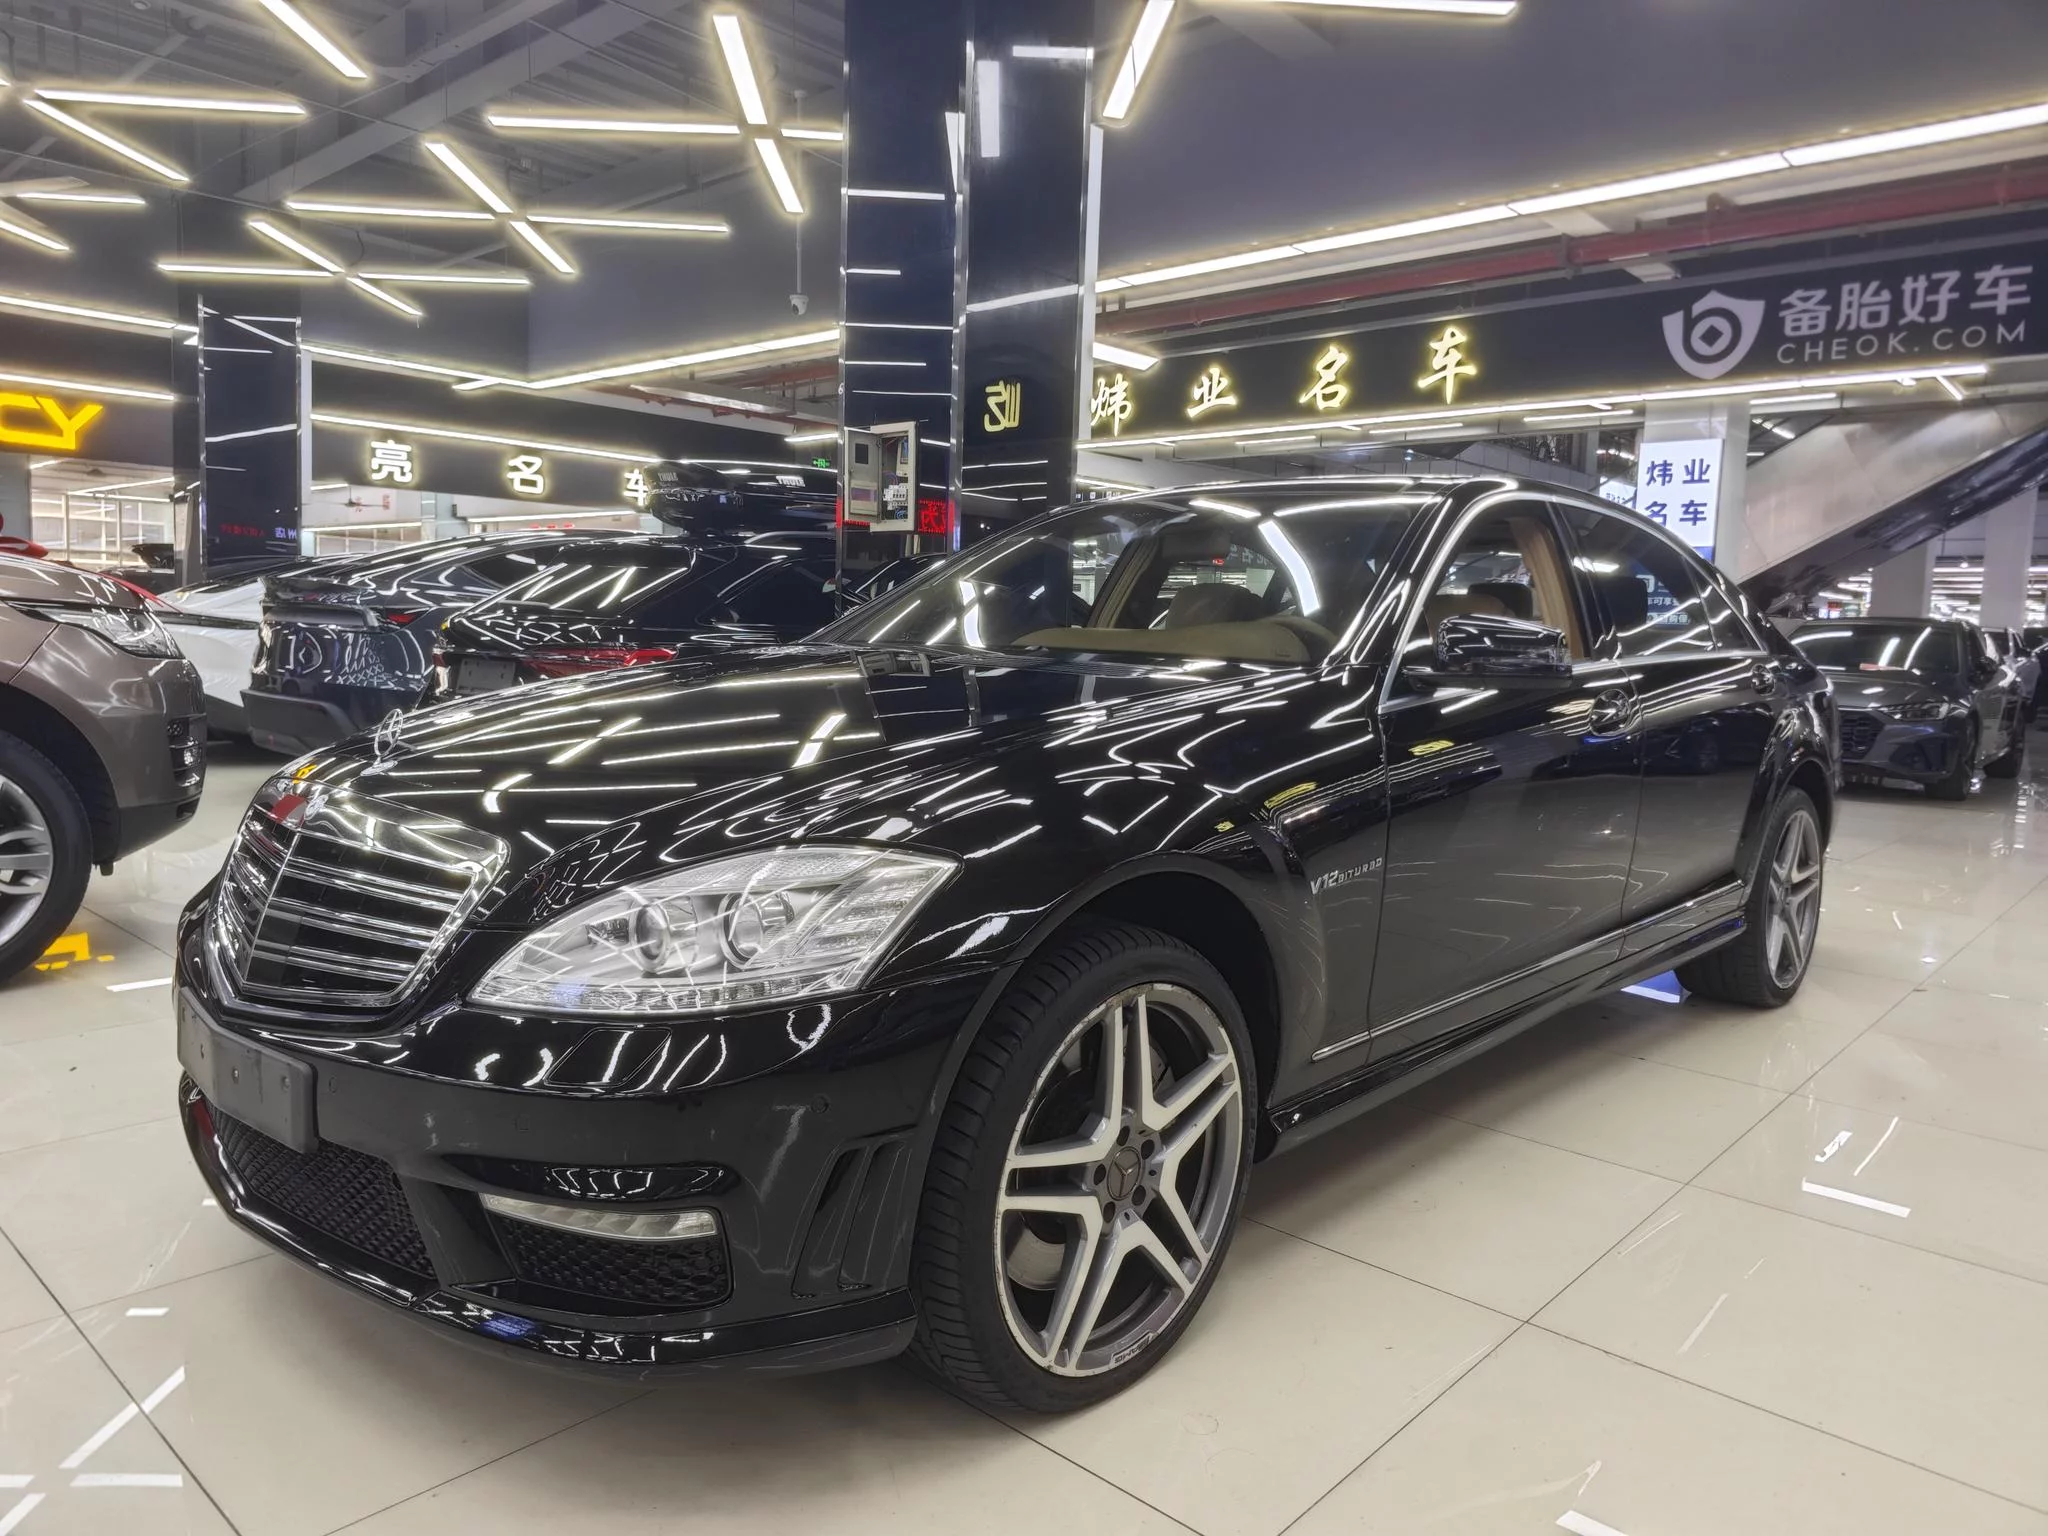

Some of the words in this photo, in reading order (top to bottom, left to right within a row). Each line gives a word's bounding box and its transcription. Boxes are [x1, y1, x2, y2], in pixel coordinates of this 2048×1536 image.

[1778, 264, 2033, 338] 备胎好车
[1777, 320, 2026, 365] CHEOK.COM
[1089, 326, 1477, 437] 炜业名车
[1646, 458, 1711, 487] 炜业
[1644, 499, 1708, 527] 名车
